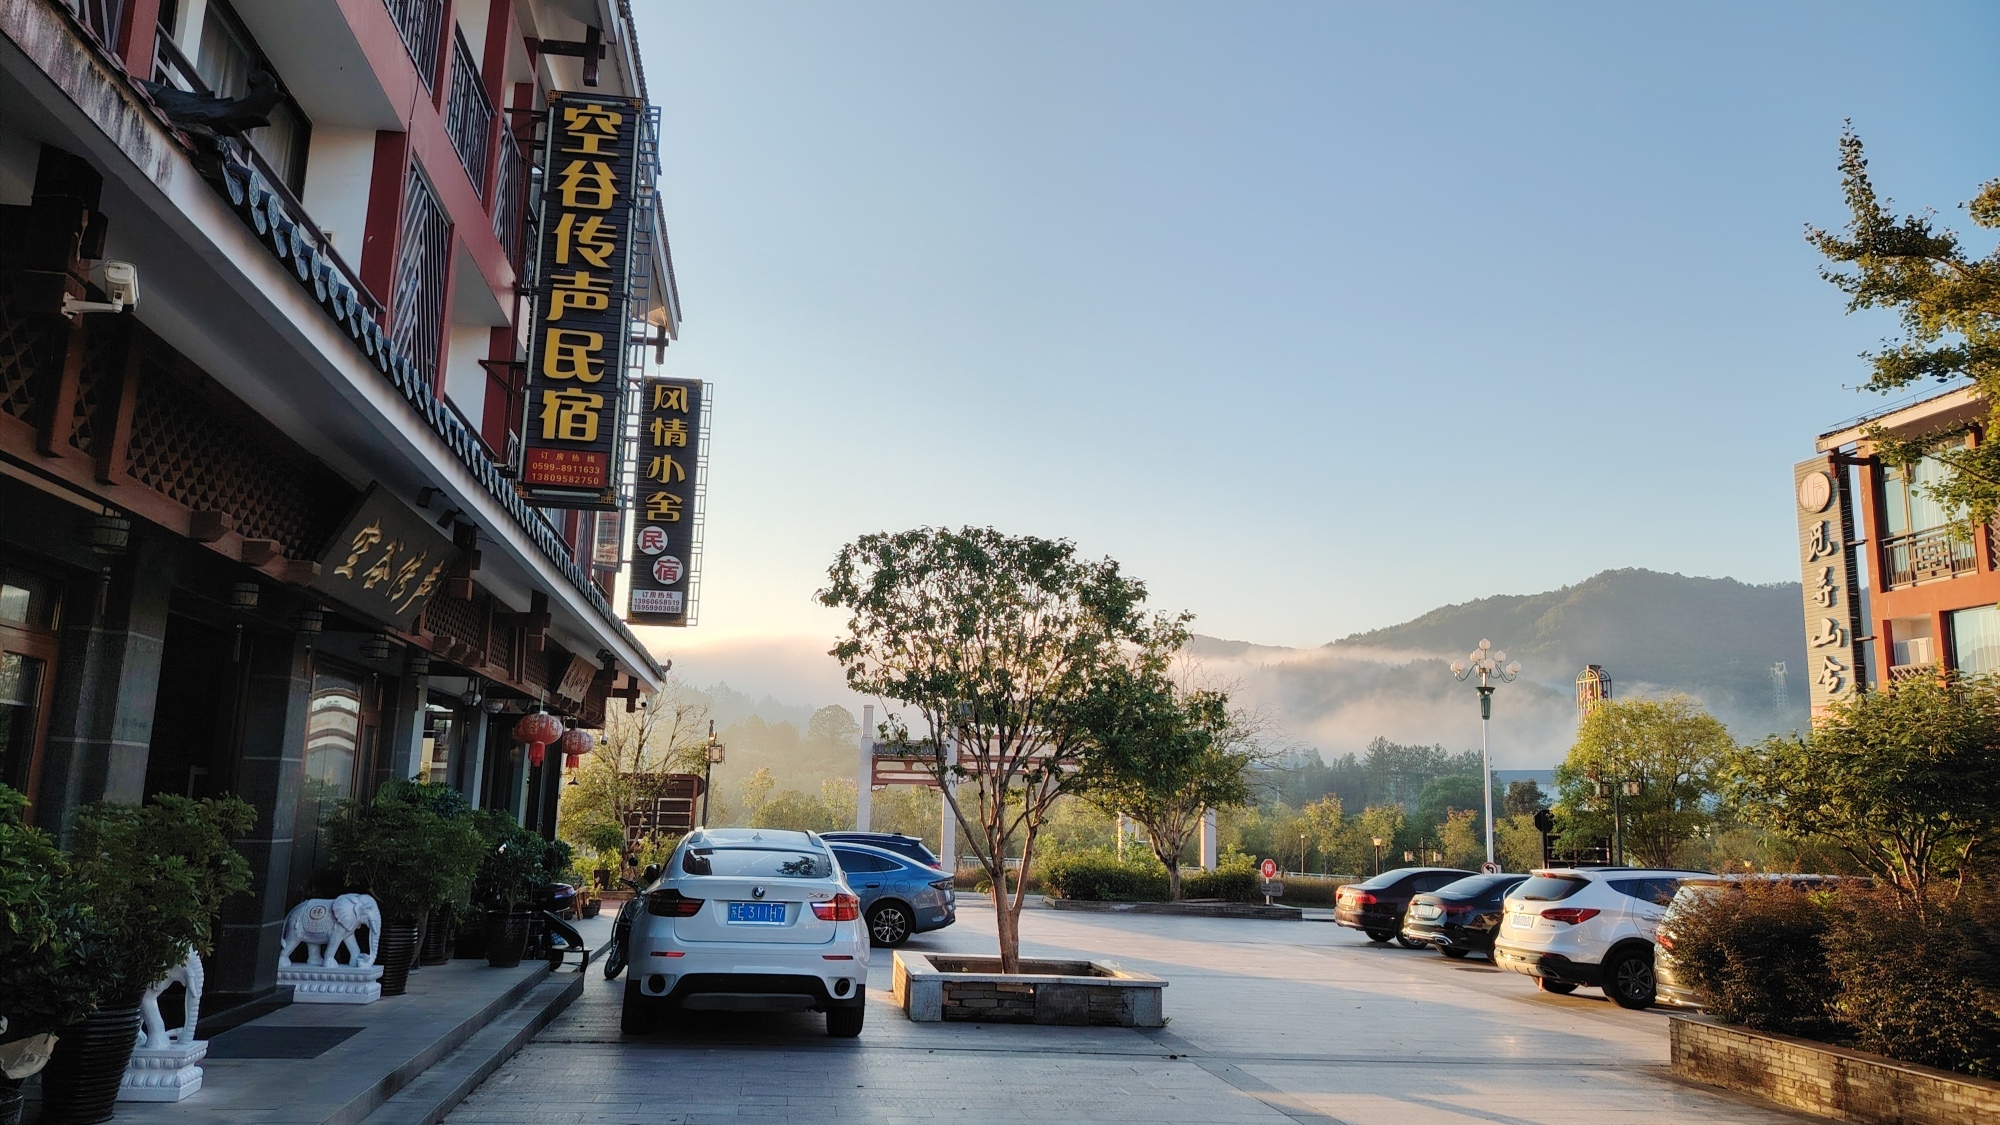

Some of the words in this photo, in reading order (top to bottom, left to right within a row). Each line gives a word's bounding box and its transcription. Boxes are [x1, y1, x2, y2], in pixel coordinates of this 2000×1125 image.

[538, 103, 623, 443] 空谷传声民宿
[540, 451, 596, 463] 订房热线
[645, 384, 690, 522] 风情小舍
[532, 462, 601, 474] 0599-8911633
[531, 472, 599, 485] 13809582750
[641, 591, 674, 599] 订房热线
[1806, 519, 1844, 694] 觅寻山舍
[1265, 863, 1273, 875] 停
